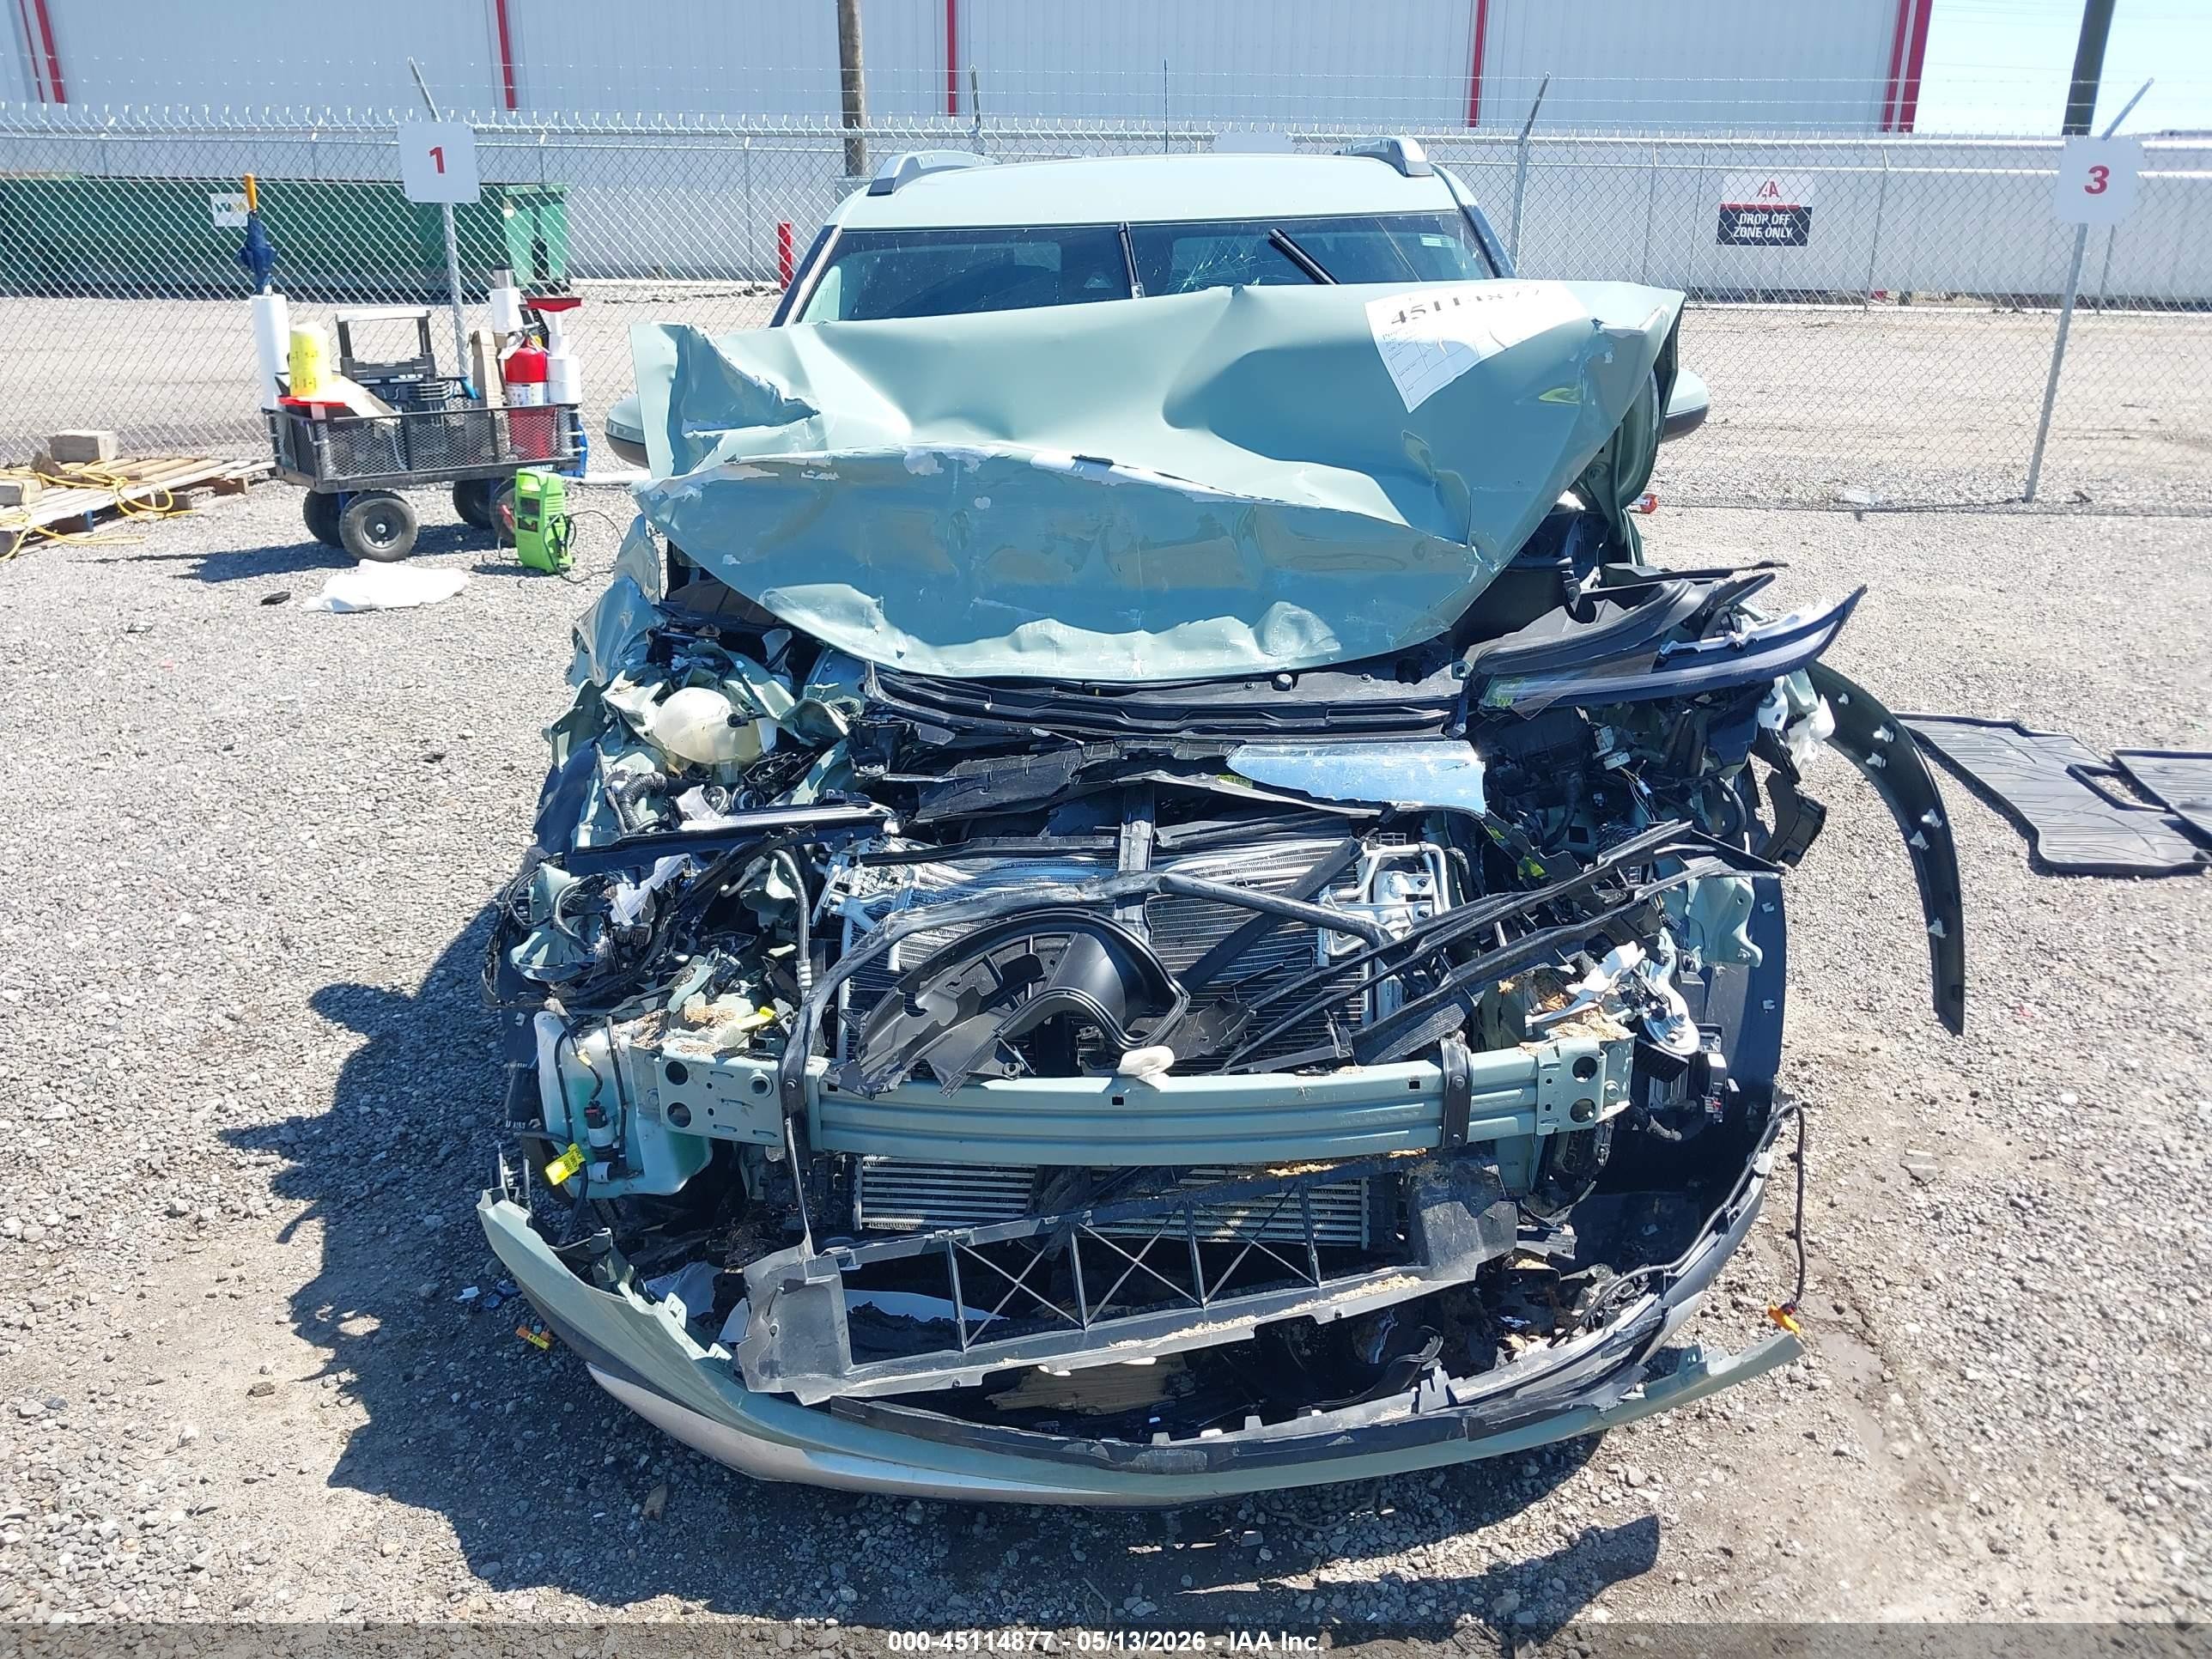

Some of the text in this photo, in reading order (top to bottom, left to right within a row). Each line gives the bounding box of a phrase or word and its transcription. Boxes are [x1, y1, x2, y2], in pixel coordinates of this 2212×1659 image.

[428, 146, 446, 173] 1
[2084, 165, 2110, 194] 3
[1738, 212, 1791, 225] DROP OFF
[1733, 226, 1794, 238] ZONE ONLY
